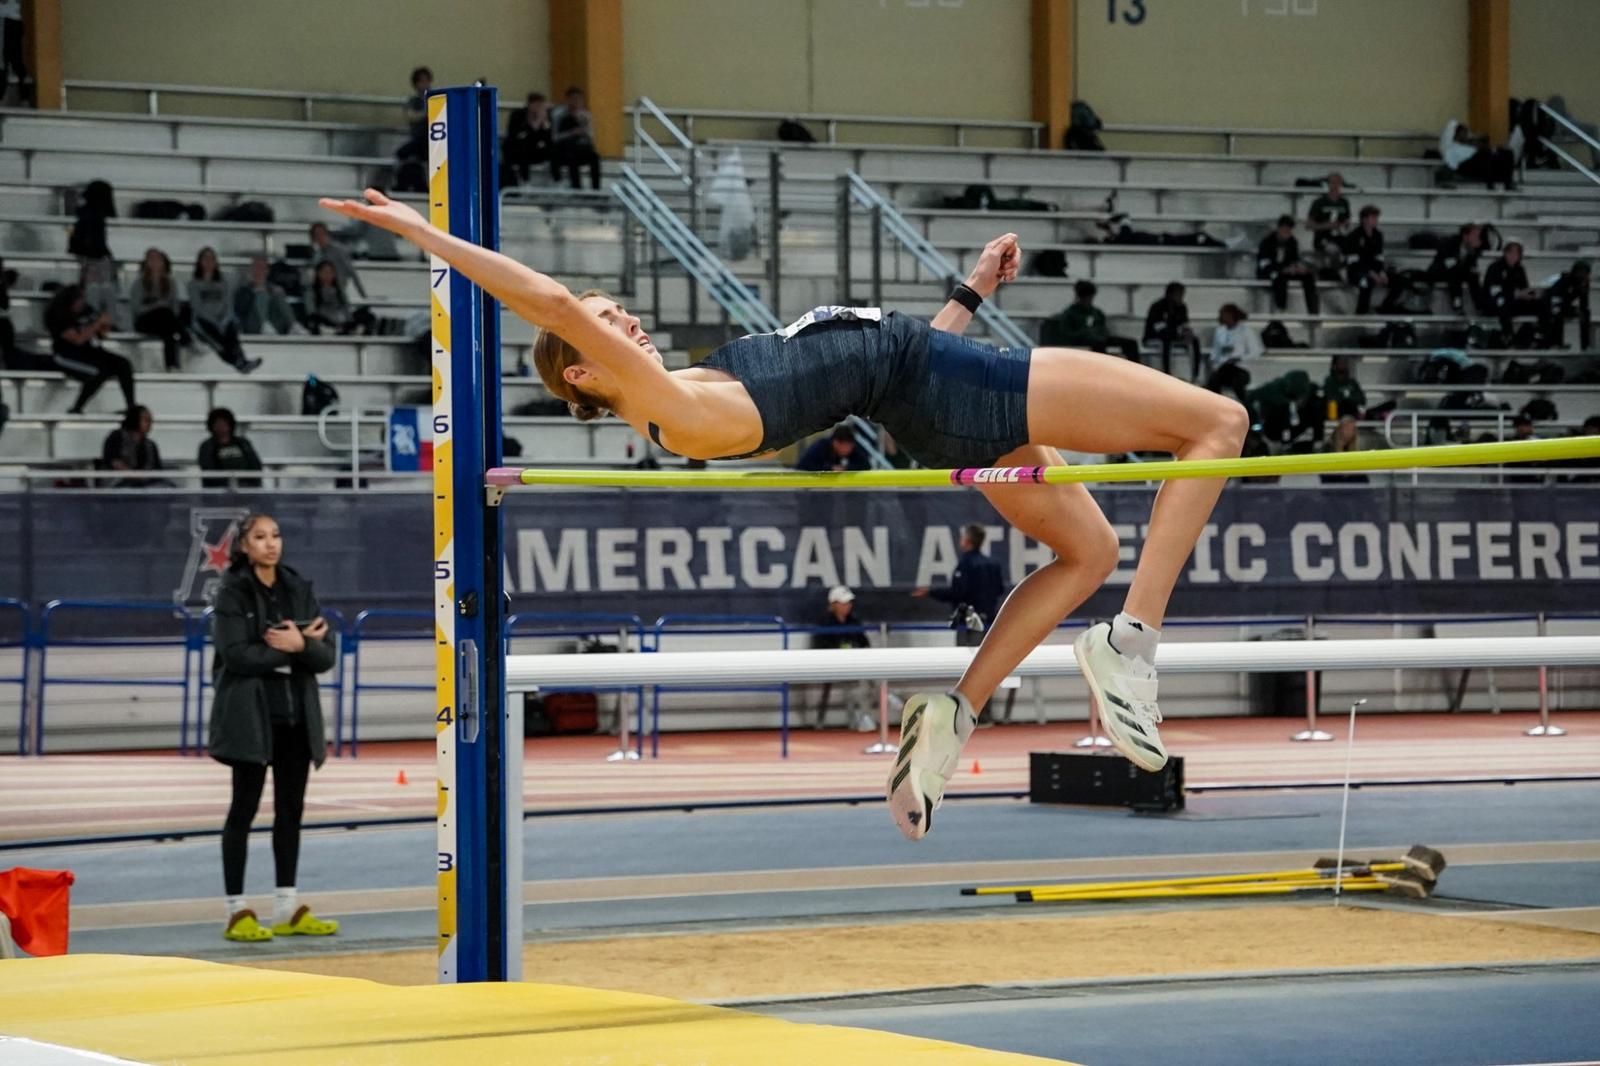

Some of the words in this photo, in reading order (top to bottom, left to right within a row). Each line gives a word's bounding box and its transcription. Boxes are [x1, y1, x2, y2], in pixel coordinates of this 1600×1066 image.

[430, 122, 447, 141] 8
[432, 269, 448, 288] 7
[433, 415, 449, 434] 6
[973, 467, 1023, 483] GILL
[503, 526, 892, 593] MERICAN
[1290, 521, 1600, 581] CONFERE
[434, 561, 451, 580] 5
[437, 706, 454, 726] 4
[438, 853, 453, 872] 3
